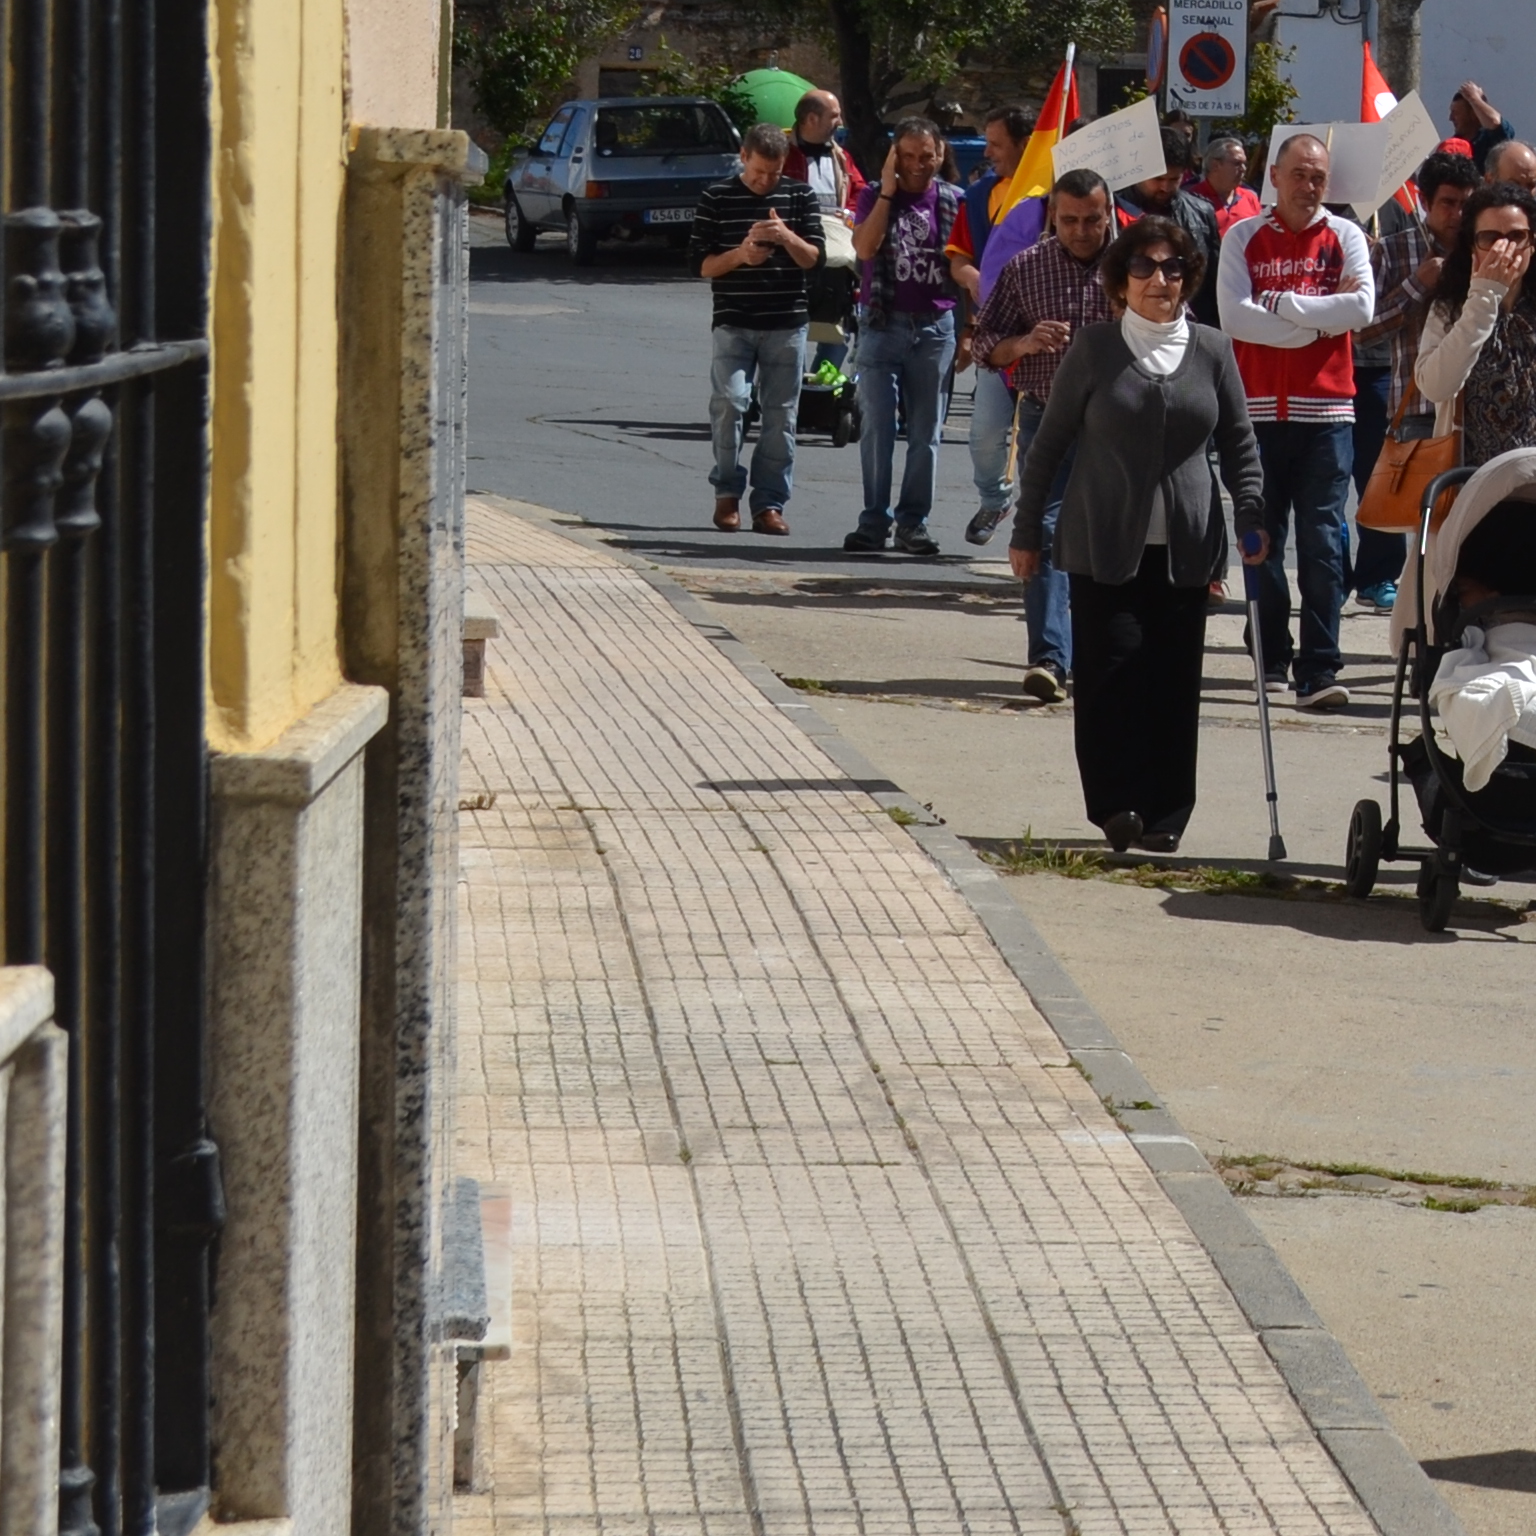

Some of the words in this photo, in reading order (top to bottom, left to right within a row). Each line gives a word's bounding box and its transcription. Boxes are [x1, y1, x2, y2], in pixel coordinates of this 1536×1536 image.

[1173, 0, 1243, 10] MERCADILLO
[1181, 15, 1234, 26] SEMANAL
[629, 48, 642, 59] 28
[1170, 100, 1197, 110] LUNES
[1199, 101, 1209, 110] DE
[1212, 102, 1216, 110] 7
[651, 209, 681, 221] 4546
